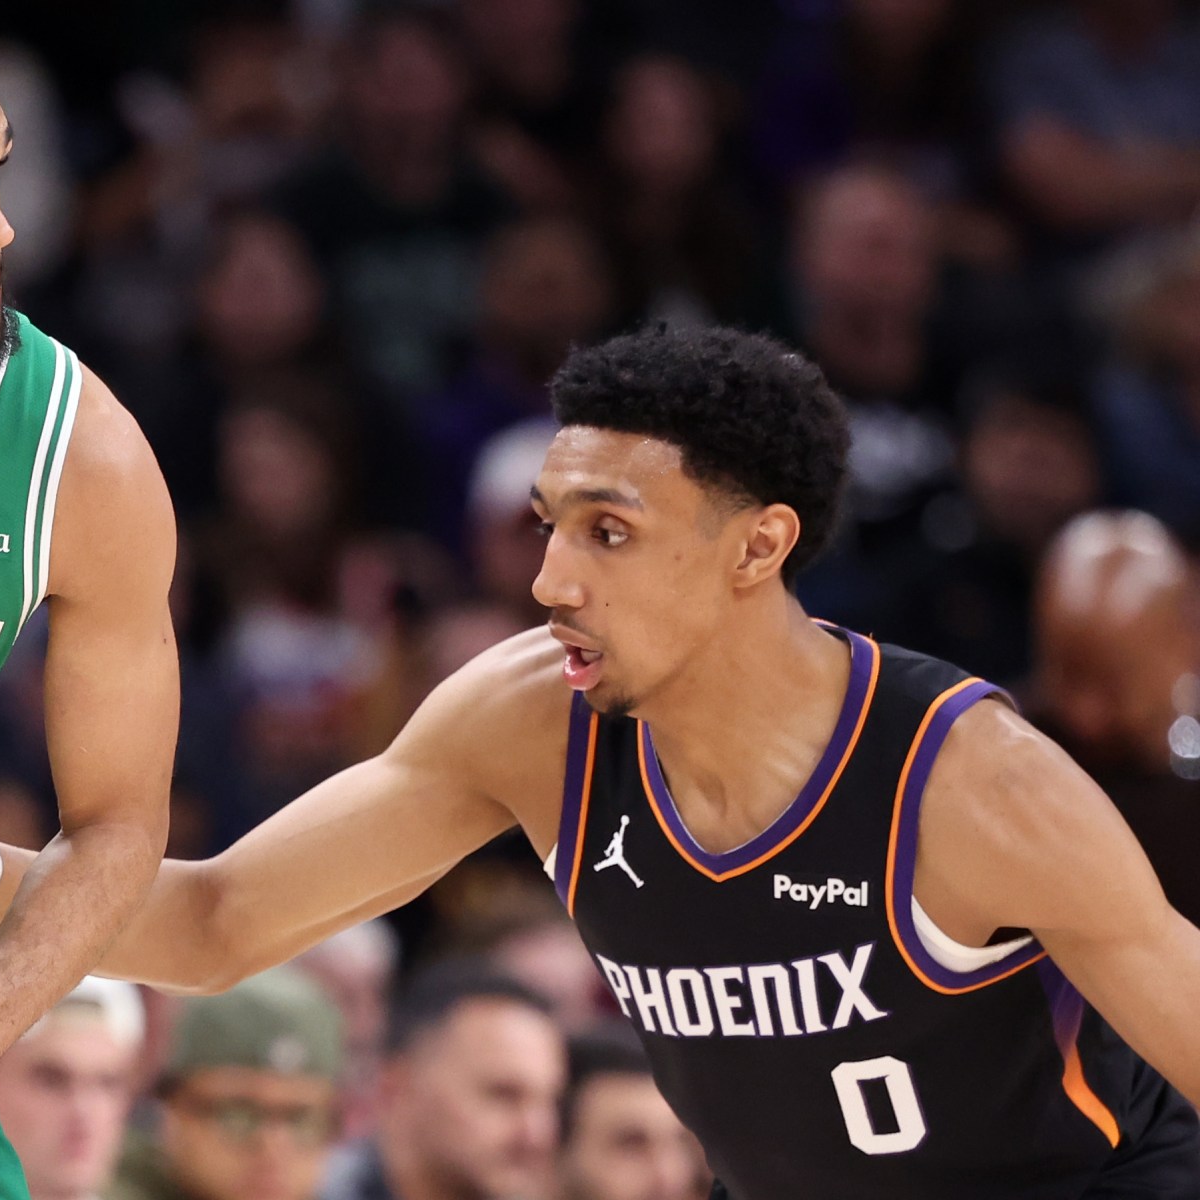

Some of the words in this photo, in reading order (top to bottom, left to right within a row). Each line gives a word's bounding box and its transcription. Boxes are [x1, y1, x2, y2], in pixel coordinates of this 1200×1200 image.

[773, 874, 868, 910] PayPal
[595, 941, 891, 1038] PHOENIX
[830, 1056, 926, 1155] 0
